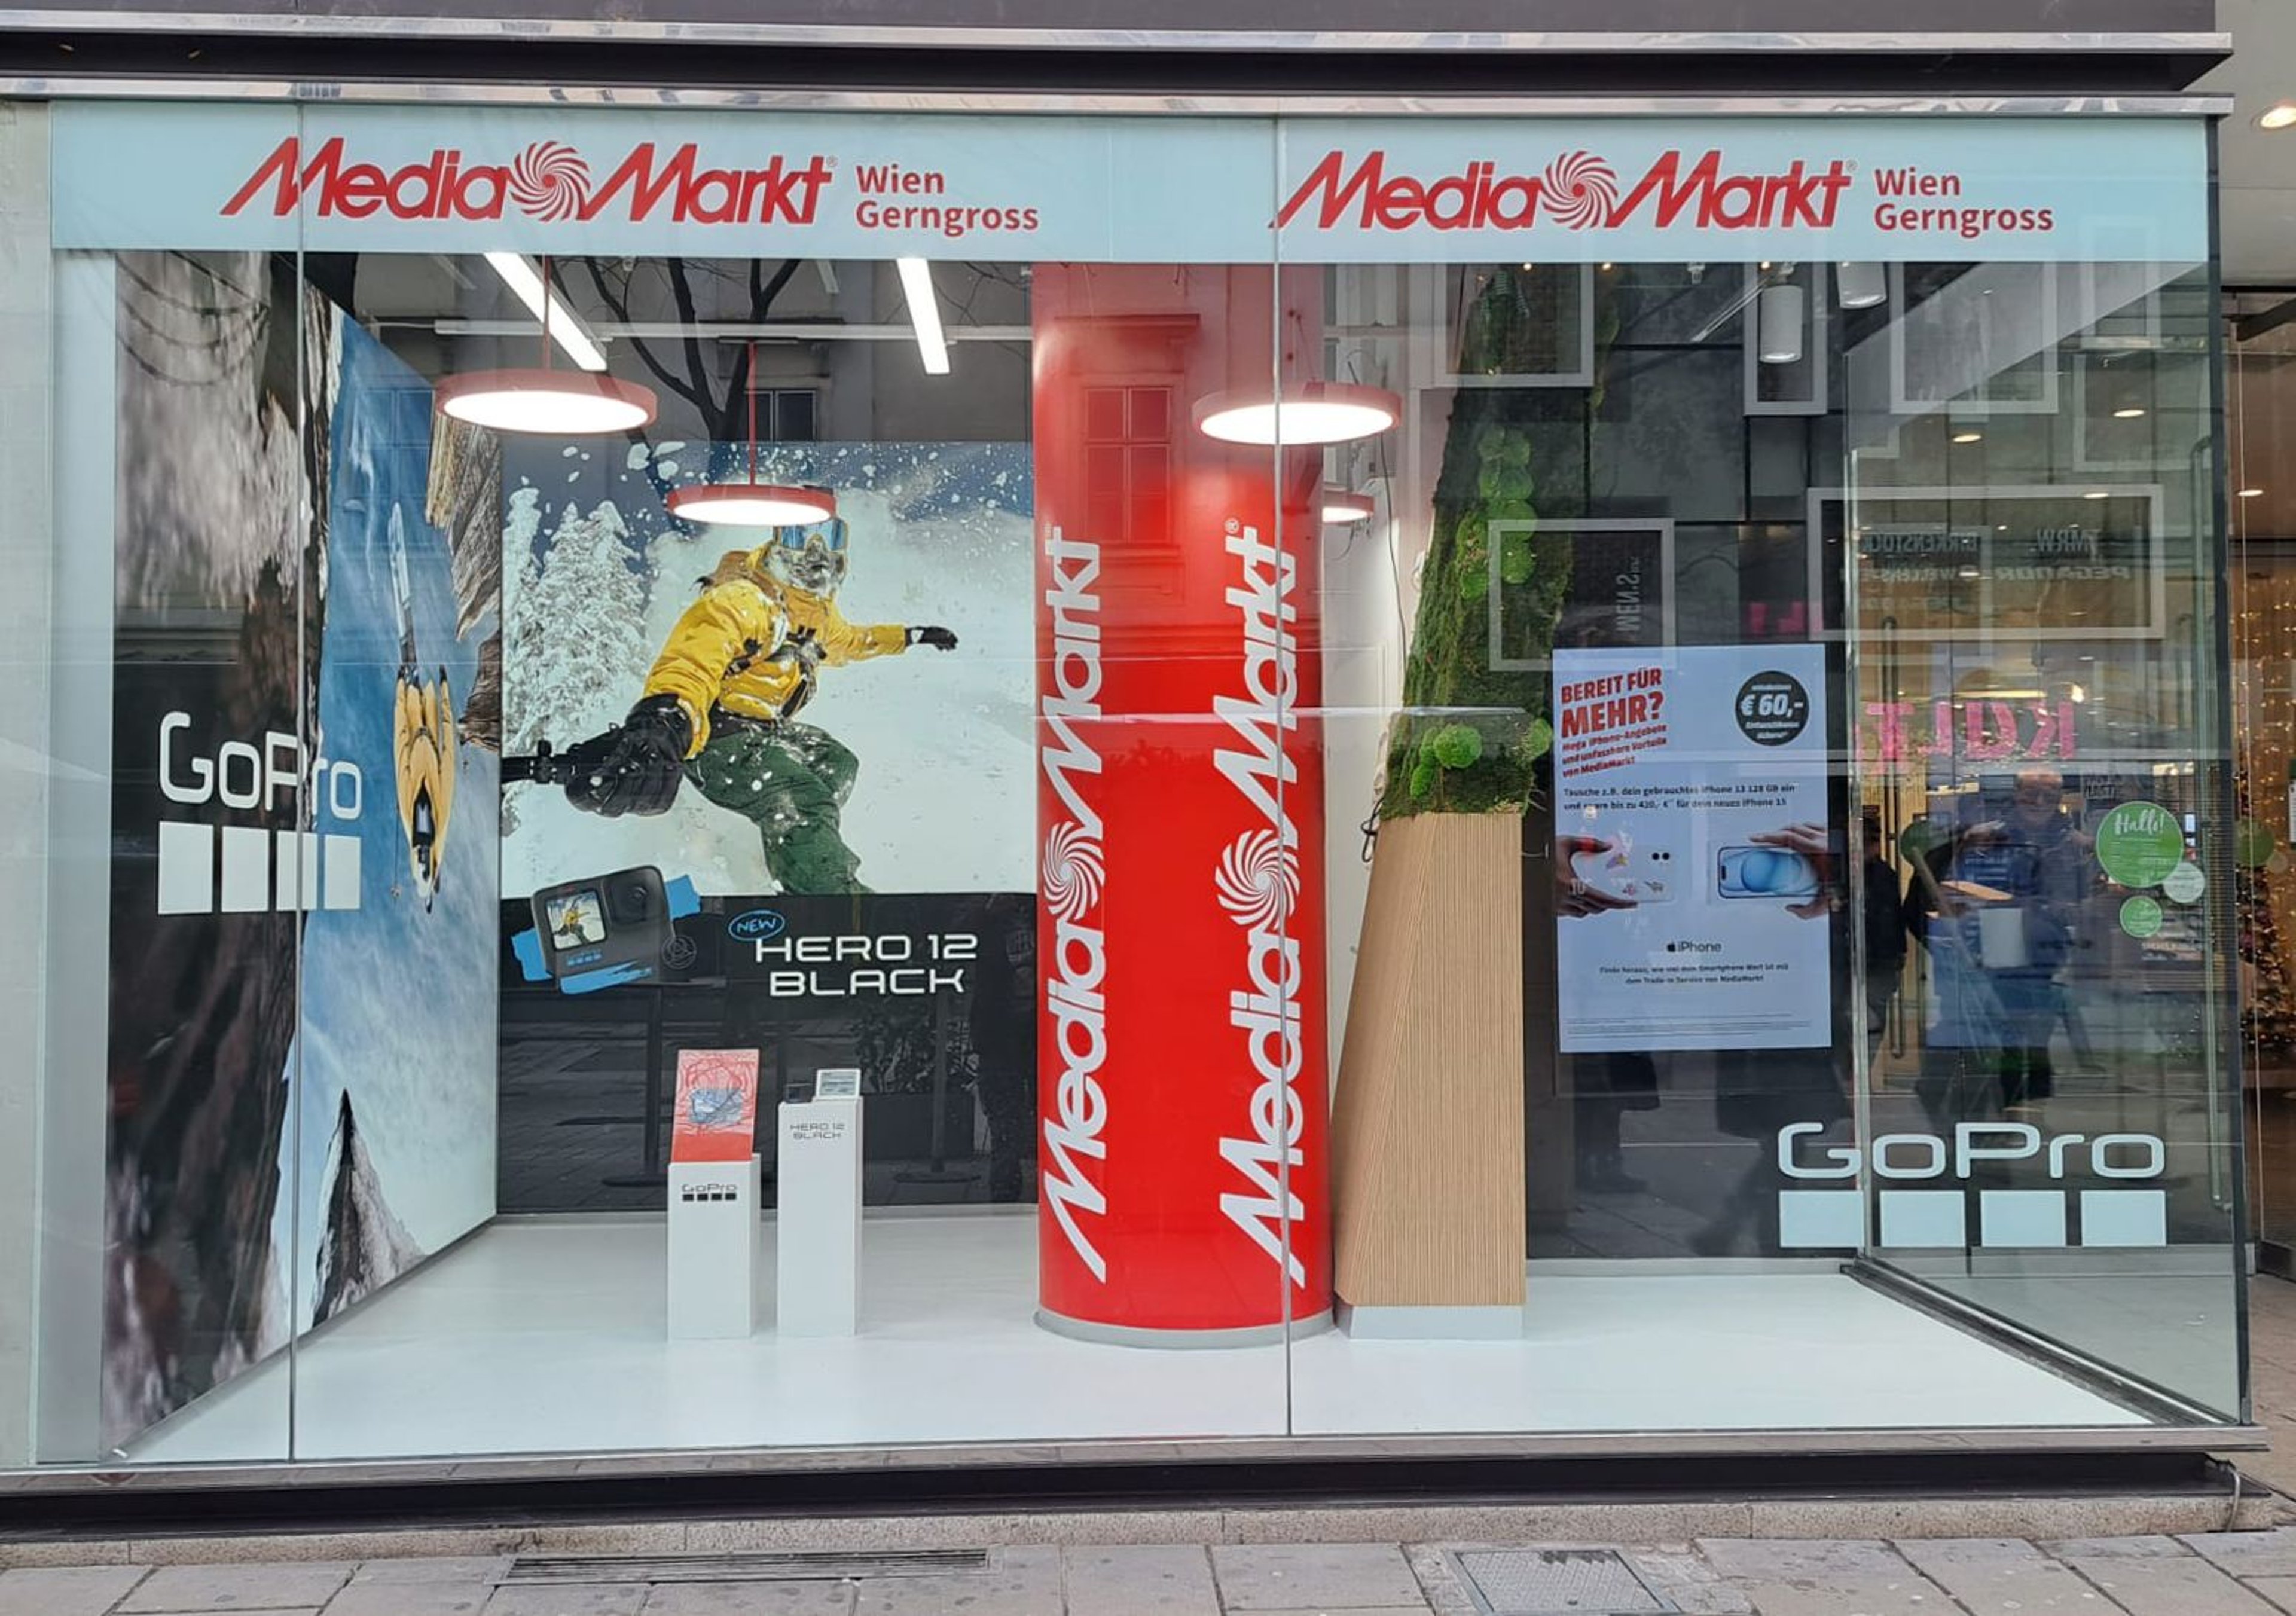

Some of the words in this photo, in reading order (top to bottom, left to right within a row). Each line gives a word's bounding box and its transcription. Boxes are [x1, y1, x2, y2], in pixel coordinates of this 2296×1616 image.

[856, 164, 944, 194] Wien
[1874, 167, 1961, 197] Wien
[856, 200, 1039, 237] Gerngross
[1874, 204, 2054, 238] Gerngross
[1561, 675, 1623, 704] BEREIT
[1627, 666, 1662, 691] FÜR
[1561, 691, 1664, 738] MEHR?
[160, 711, 362, 820] GoPro
[736, 917, 778, 933] NEW
[756, 935, 911, 962] HERO
[928, 933, 978, 960] 12
[1678, 941, 1722, 952] iPhone
[770, 968, 965, 996] BLACK
[790, 1123, 830, 1131] HERO
[1778, 1122, 2166, 1179] GoPro
[682, 1183, 737, 1192] GoPro
